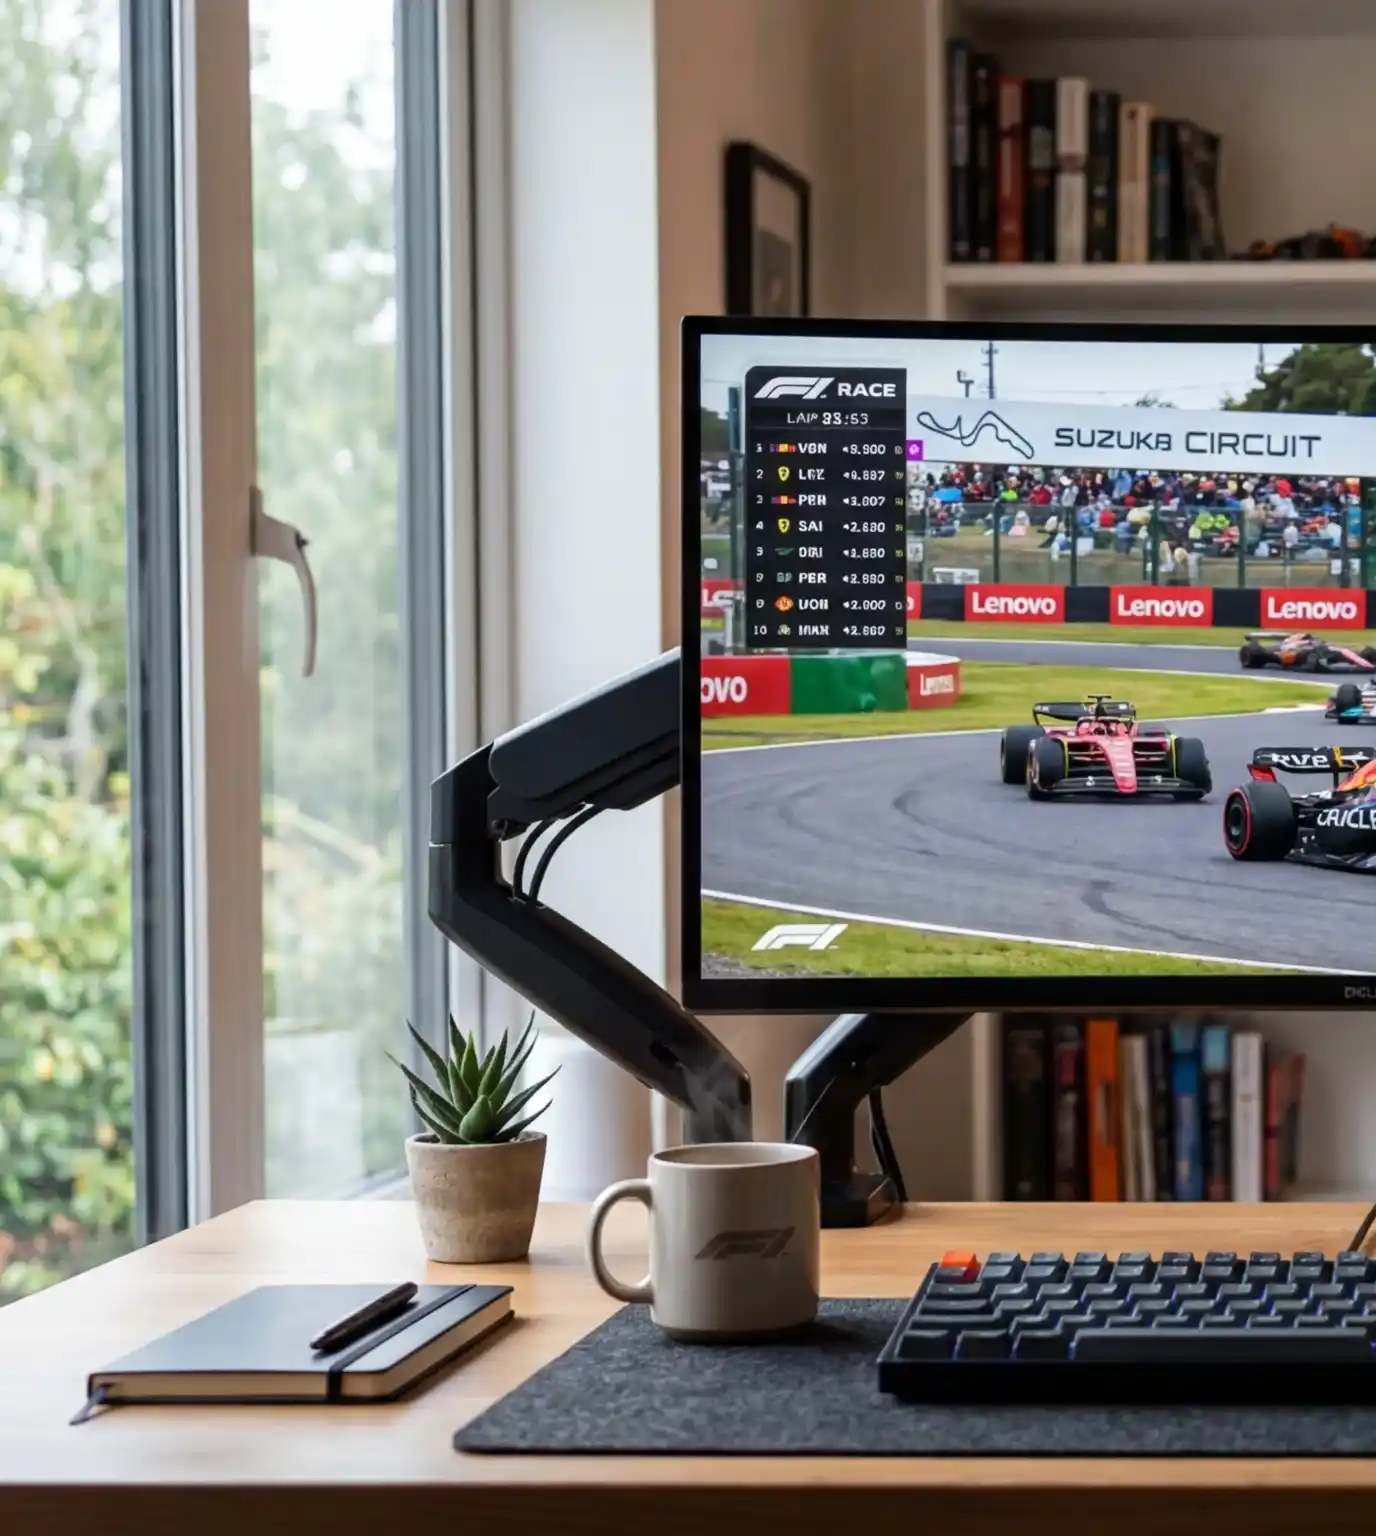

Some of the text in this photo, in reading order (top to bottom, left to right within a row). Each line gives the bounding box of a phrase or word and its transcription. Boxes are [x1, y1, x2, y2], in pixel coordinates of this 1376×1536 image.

[837, 382, 897, 398] RACE
[1185, 431, 1322, 458] CIRCUIT
[972, 592, 1057, 615] Lenovo
[1118, 595, 1205, 618] Lenovo
[1267, 596, 1357, 620] Lenovo
